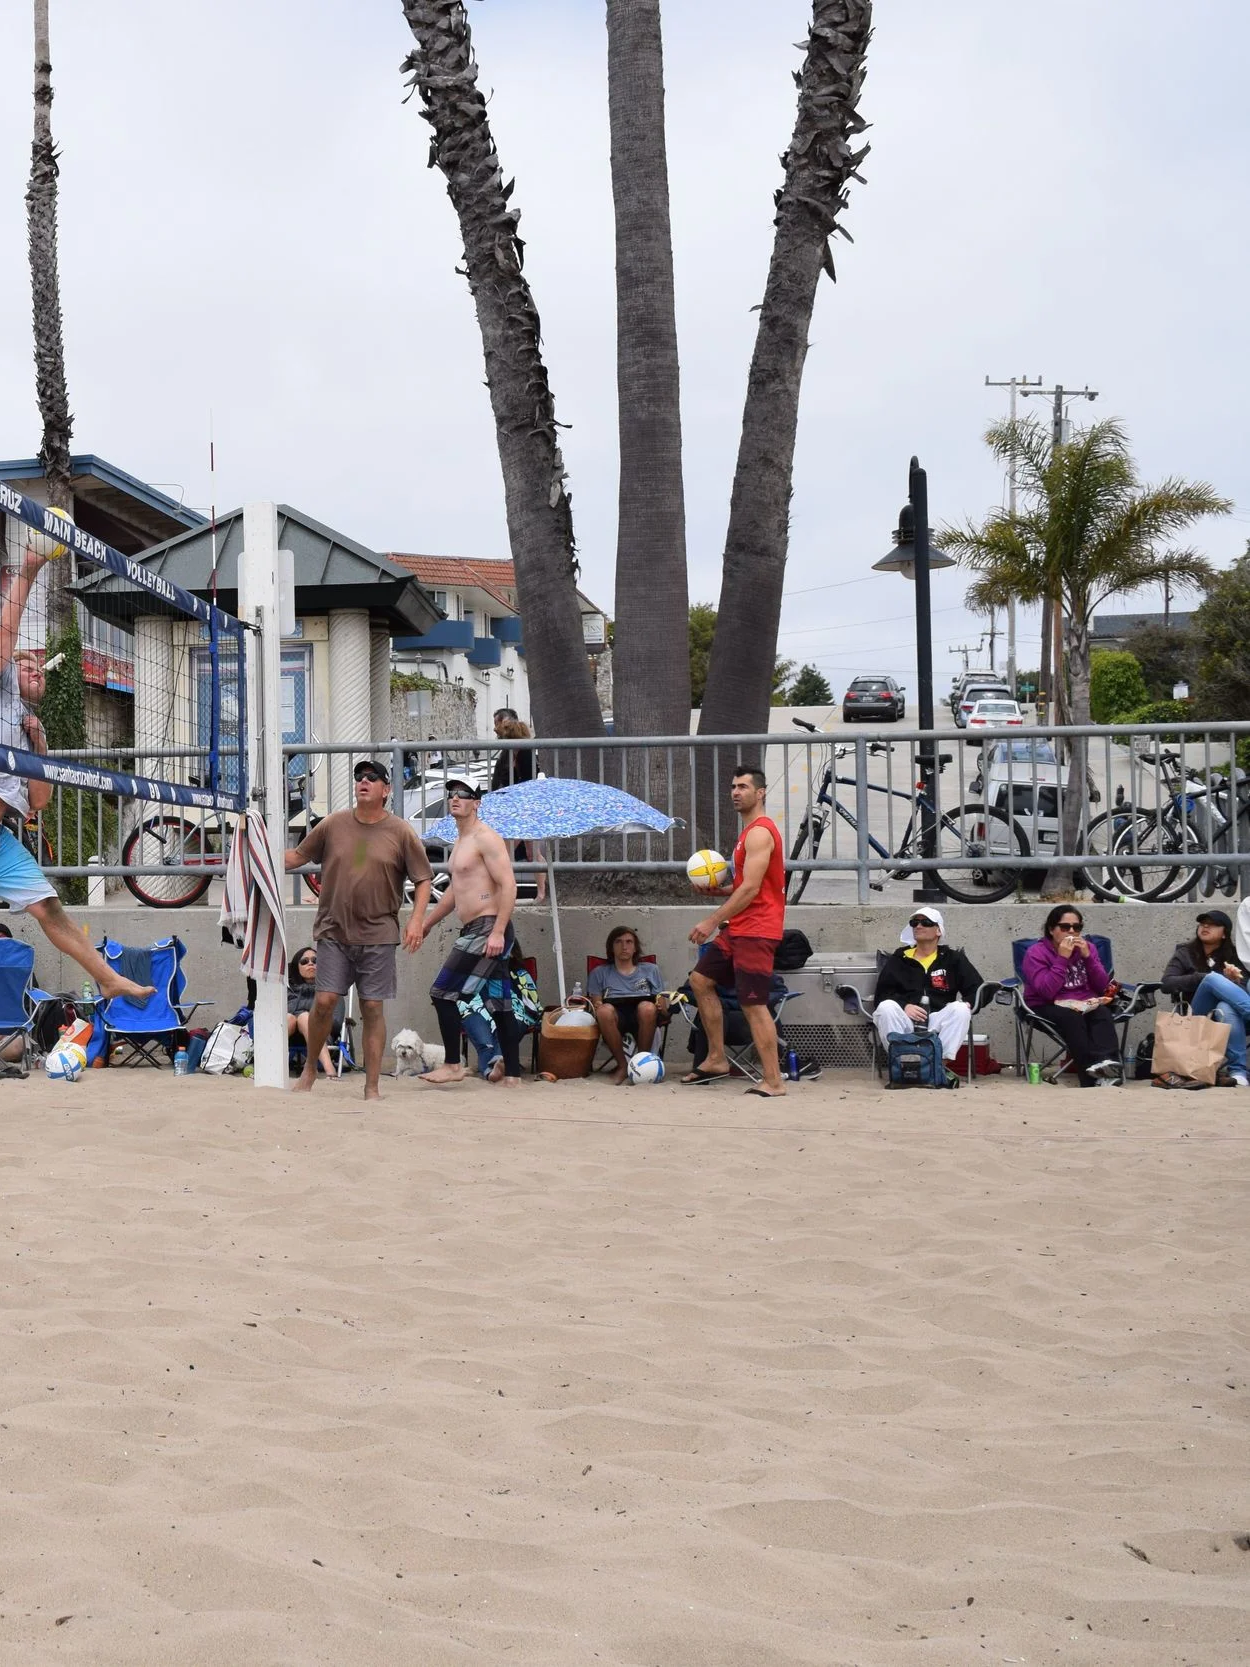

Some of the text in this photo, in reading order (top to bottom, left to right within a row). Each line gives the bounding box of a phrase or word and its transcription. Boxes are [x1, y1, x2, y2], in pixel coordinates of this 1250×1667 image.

[44, 510, 70, 543] MAIN
[74, 529, 107, 563] BEACH
[126, 559, 175, 601] VOLLEYBALL
[42, 763, 113, 791] www.santacruzwharf.com
